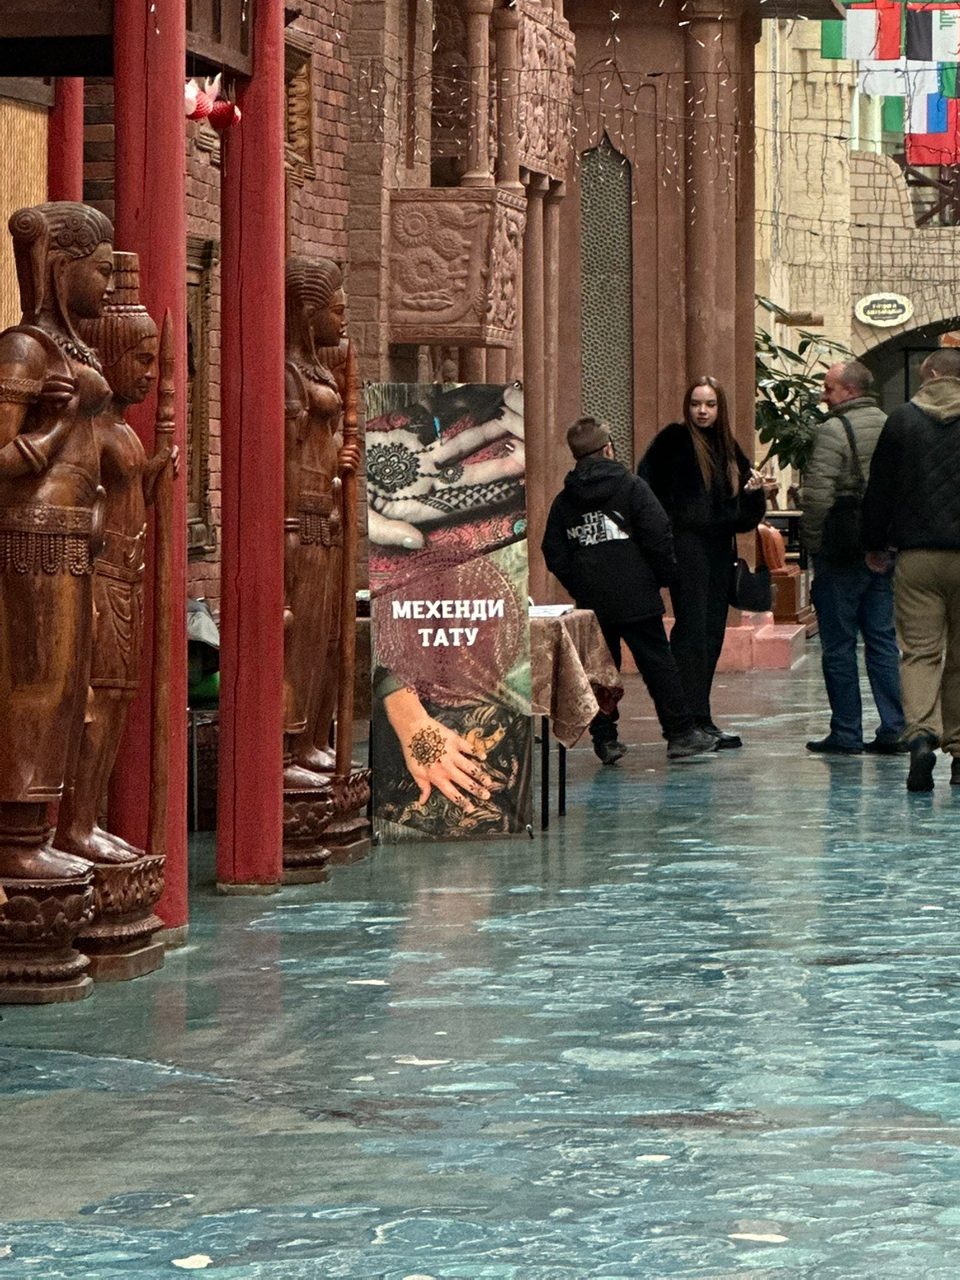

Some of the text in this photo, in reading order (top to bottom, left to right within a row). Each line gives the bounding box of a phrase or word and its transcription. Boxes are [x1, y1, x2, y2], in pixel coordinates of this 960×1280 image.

[581, 510, 604, 524] THE
[566, 518, 606, 540] NORTH
[578, 531, 607, 547] FACE
[391, 599, 505, 621] МЕХЕНДИ
[418, 627, 479, 648] ТАТУ
